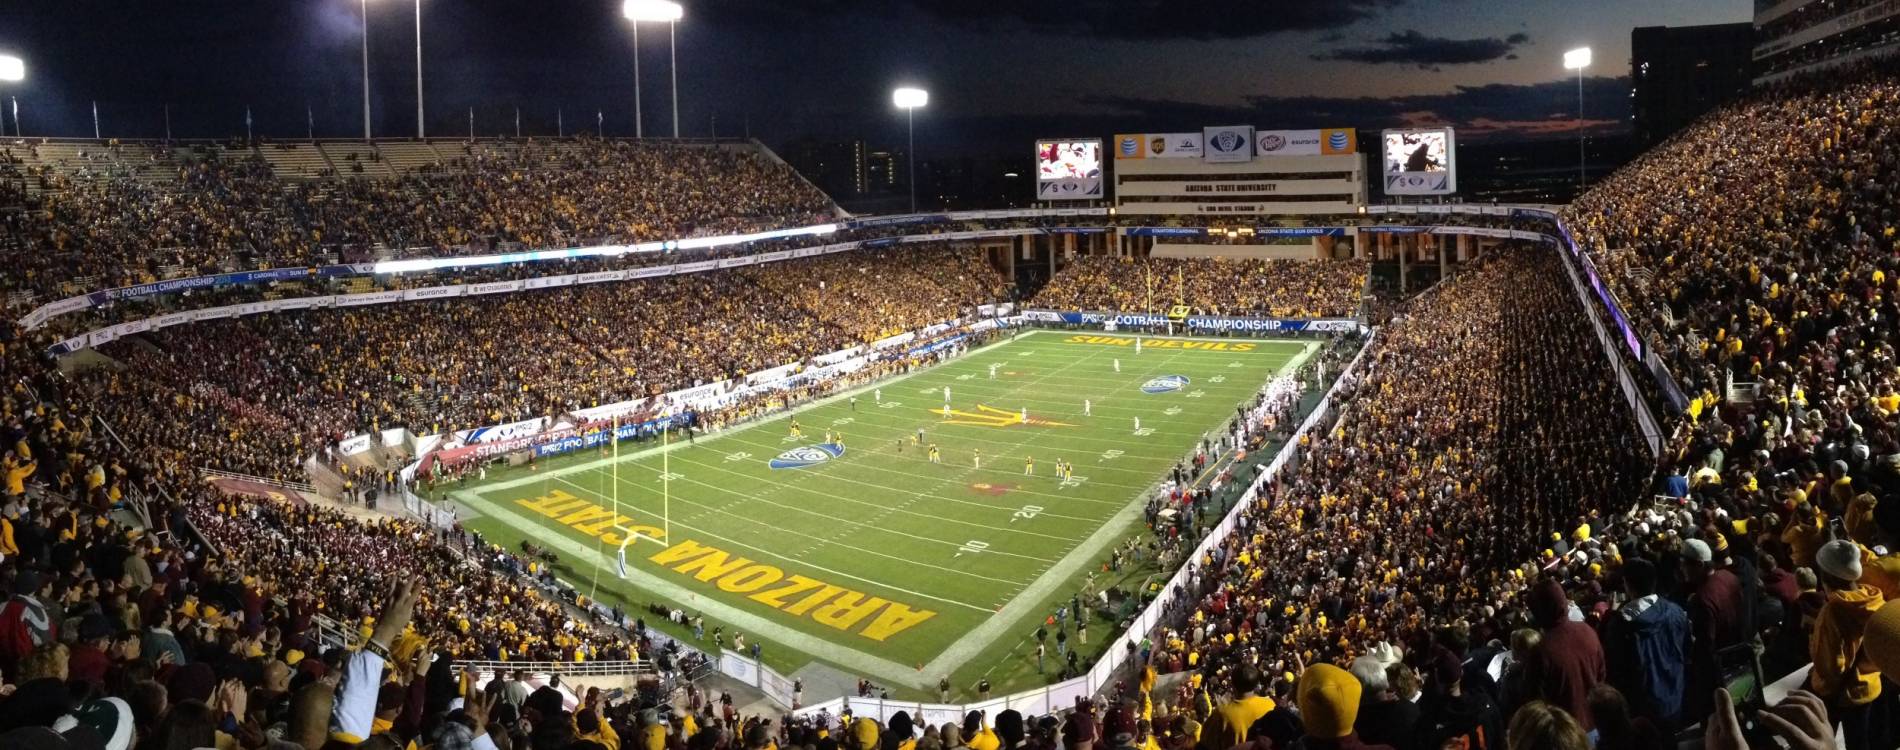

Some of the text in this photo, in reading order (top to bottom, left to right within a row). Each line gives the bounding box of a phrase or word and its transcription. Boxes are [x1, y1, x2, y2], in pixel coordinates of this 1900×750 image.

[122, 285, 158, 297] FOOTBALL
[159, 277, 214, 292] CHAMPIONSHIP
[1116, 314, 1166, 326] OOTBALL
[1188, 318, 1281, 330] CHAMPIONSHIP
[1064, 335, 1256, 351] SUN DEVILS
[680, 388, 712, 400] esurance
[564, 432, 608, 449] FOOBALL
[514, 490, 667, 546] STATE
[1013, 505, 1044, 518] 20
[959, 540, 990, 552] 10
[648, 539, 938, 641] ARIZONA
